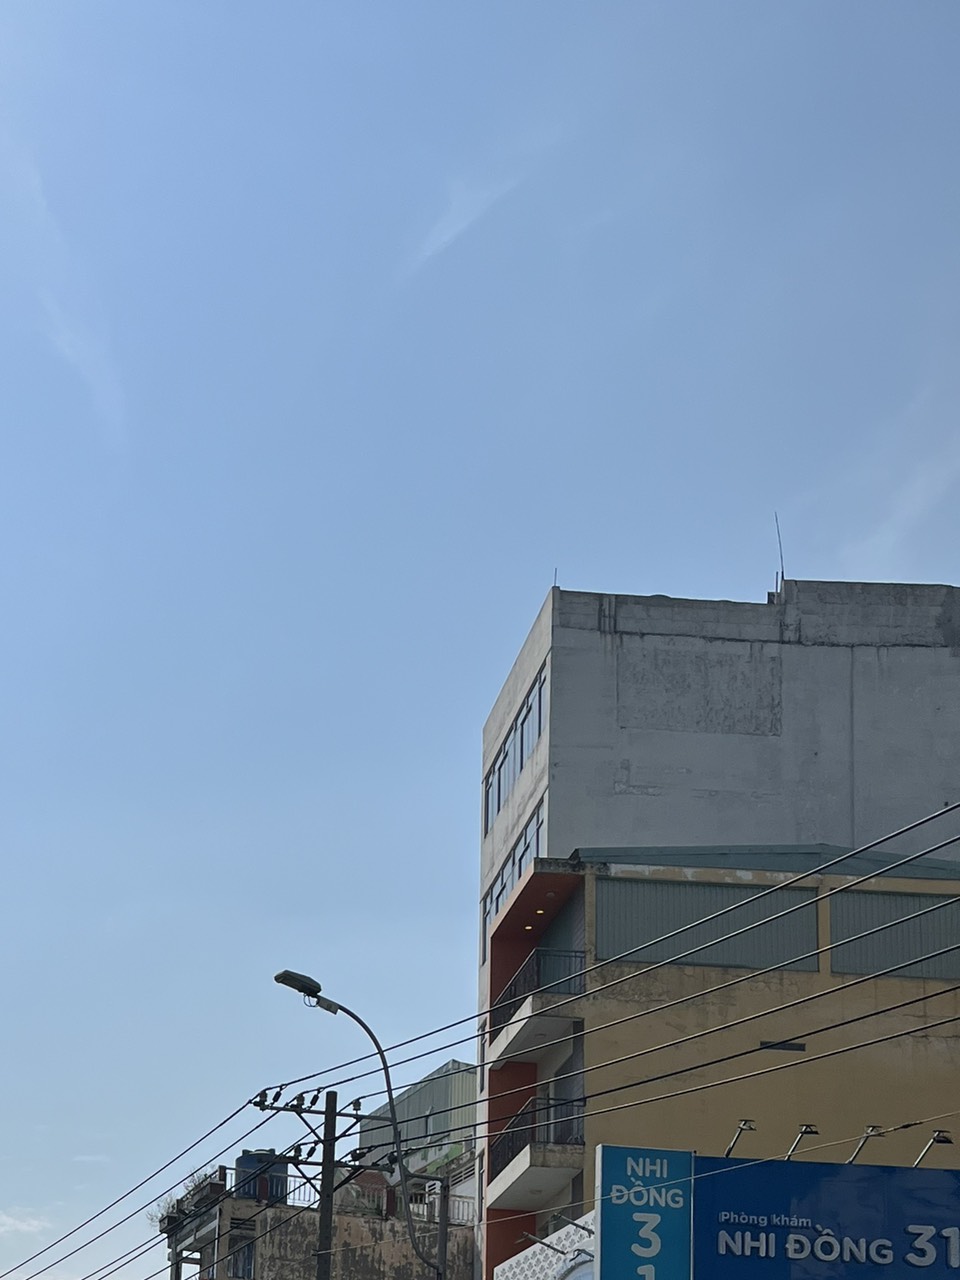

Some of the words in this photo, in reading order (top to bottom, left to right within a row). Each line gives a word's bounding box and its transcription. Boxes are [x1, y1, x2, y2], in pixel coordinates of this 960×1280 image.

[627, 1157, 668, 1179] NHI
[610, 1177, 684, 1209] ĐỒNG
[719, 1211, 768, 1227] Phòng
[771, 1213, 812, 1228] khám
[718, 1230, 776, 1258] NHI
[784, 1224, 894, 1266] ĐỒNG
